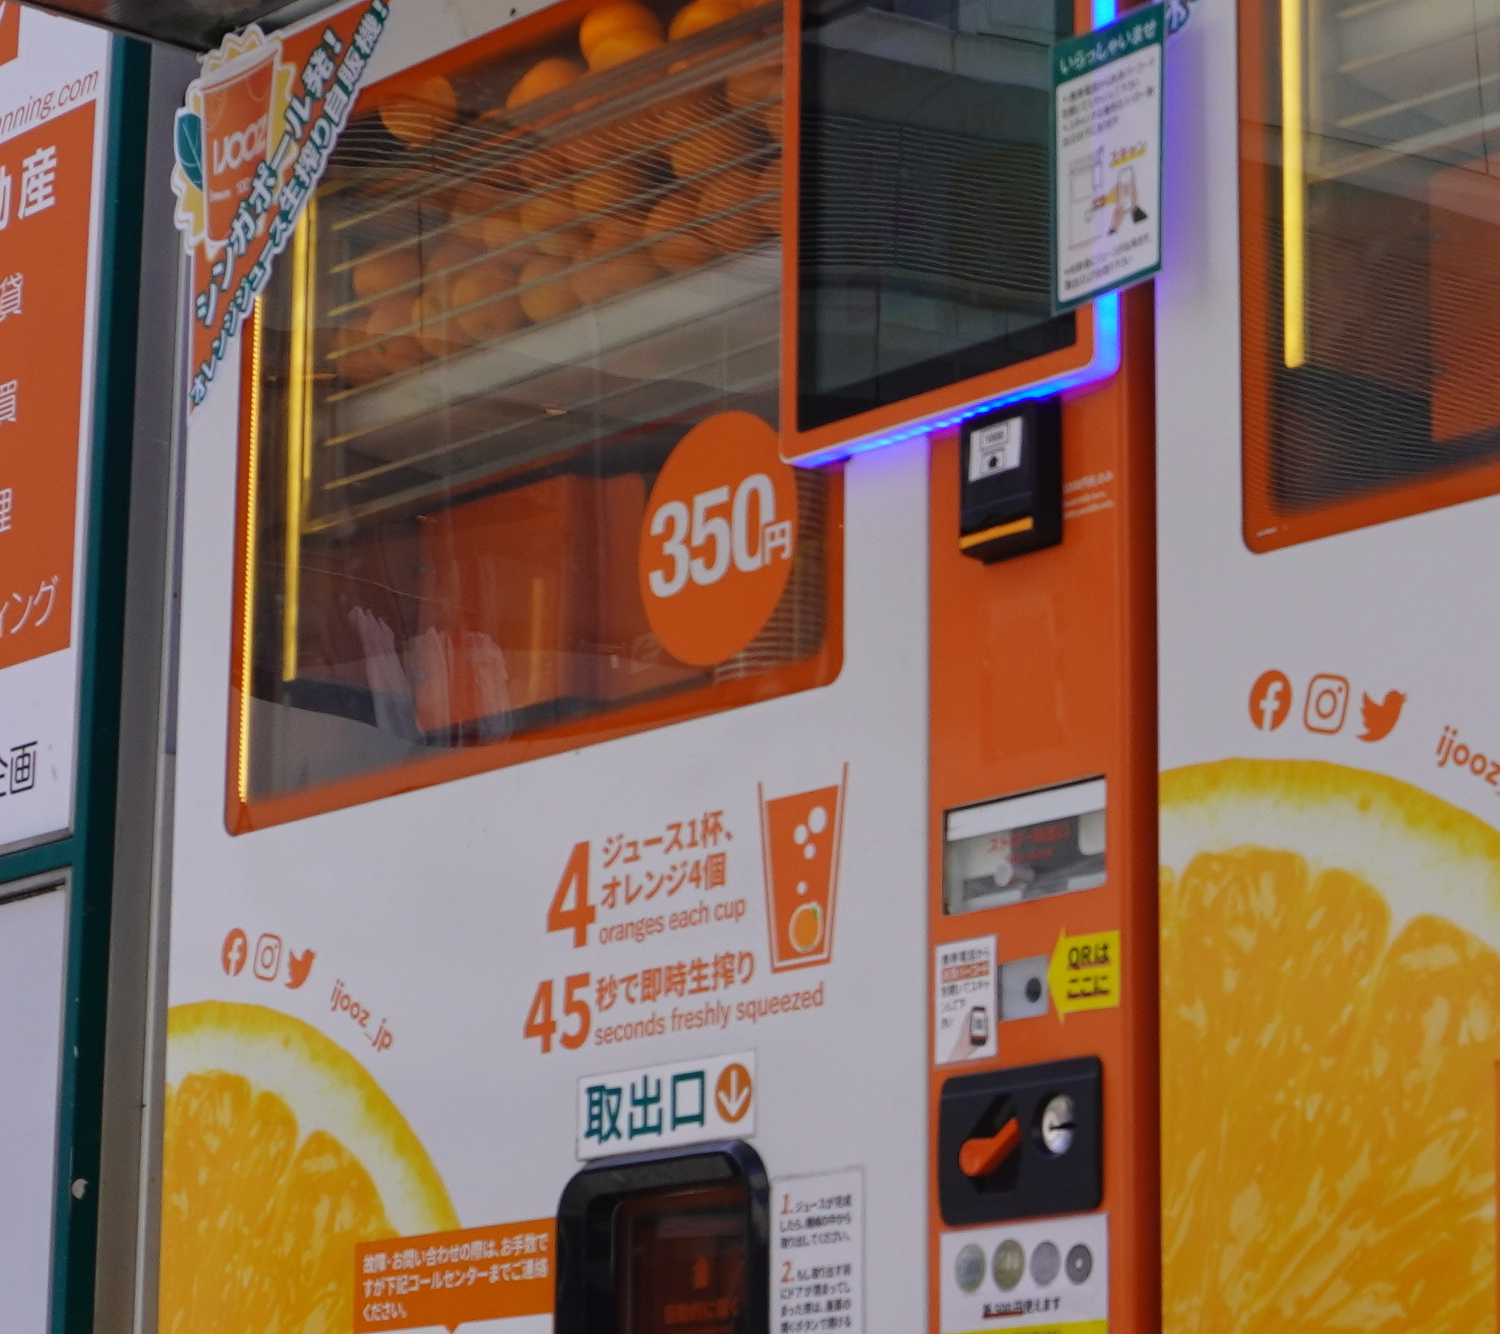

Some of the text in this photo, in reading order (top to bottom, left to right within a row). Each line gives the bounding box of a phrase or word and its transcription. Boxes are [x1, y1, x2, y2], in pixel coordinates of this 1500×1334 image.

[195, 25, 343, 327] シンガポール発!
[648, 472, 793, 599] 350円
[602, 809, 735, 869] ジュース1杯、
[546, 840, 597, 949] 4
[601, 851, 728, 910] オレンジ4個
[599, 897, 747, 946] oranges each cup
[1068, 943, 1111, 968] QRは
[330, 978, 395, 1053] ijooz_jp
[523, 971, 593, 1055] 45
[595, 949, 756, 1014] 秒で即時生搾り
[595, 981, 825, 1046] seconds freshly squeezed
[584, 1069, 707, 1145] 取出口
